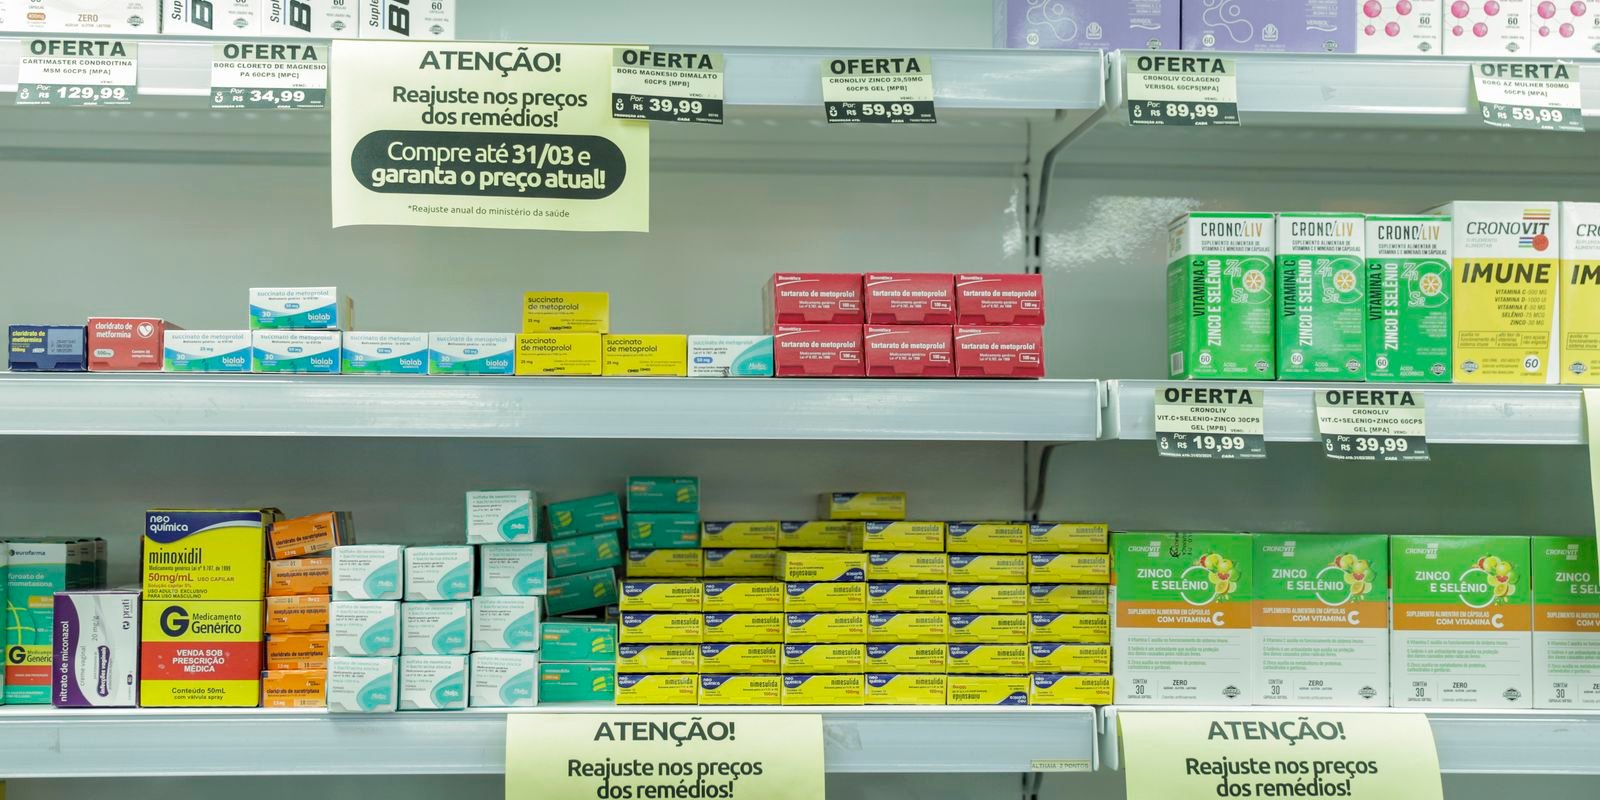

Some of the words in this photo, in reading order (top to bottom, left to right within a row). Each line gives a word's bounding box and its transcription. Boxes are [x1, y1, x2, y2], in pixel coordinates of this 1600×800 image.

[77, 14, 99, 22] ZERO
[1419, 16, 1430, 25] 60
[30, 39, 127, 57] OFERTA
[223, 43, 318, 60] OFERTA
[418, 46, 562, 78] ATENÇÃO!
[622, 49, 713, 70] OFERTA
[830, 57, 921, 75] OFERTA
[1137, 56, 1226, 73] OFERTA
[1480, 63, 1570, 79] OFERTA
[669, 80, 690, 88] [MPB]
[56, 86, 125, 101] 129,99
[249, 90, 305, 104] 34,99
[392, 85, 479, 107] Reajuste
[483, 91, 518, 105] nos
[522, 91, 588, 111] preços
[649, 98, 703, 116] 39,99
[862, 103, 915, 118] 59,99
[1166, 103, 1218, 120] 89,99
[1512, 107, 1563, 123] 59,99
[421, 105, 458, 125] dos
[461, 107, 559, 128] remédios!
[387, 141, 472, 166] Compre
[475, 142, 509, 163] até
[511, 143, 574, 169] 31/03
[577, 150, 592, 166] e
[371, 166, 457, 188] garanta
[460, 170, 476, 186] o
[479, 170, 542, 192] preço
[544, 168, 606, 190] atual!
[450, 205, 474, 214] anual
[475, 206, 487, 215] do
[488, 206, 531, 217] ministério
[532, 208, 543, 217] da
[545, 208, 570, 218] saúde
[1466, 221, 1550, 235] CRONOVIT
[1192, 259, 1205, 267] C
[1461, 262, 1551, 284] IMUNE
[1205, 259, 1222, 304] SELÊNIO
[1382, 262, 1399, 307] SELÊNIO
[527, 296, 564, 304] succinato
[820, 290, 855, 299] metoprolol
[1192, 267, 1206, 317] VITAMINA
[539, 303, 579, 311] metoprolol
[1207, 305, 1222, 313] E
[1384, 309, 1399, 317] E
[1207, 315, 1222, 347] ZINCO
[1384, 318, 1399, 350] ZINCO
[1524, 358, 1539, 369] 60
[1164, 388, 1253, 405] OFERTA
[1325, 390, 1416, 406] OFERTA
[1157, 415, 1236, 423] VIT.C+SELENIO+ZINCO
[1193, 436, 1245, 452] 19,99
[1356, 437, 1408, 454] 39,99
[149, 515, 170, 523] neo
[149, 522, 189, 534] química
[148, 547, 202, 564] minoxidil
[148, 572, 194, 583] 50mg/mL
[1137, 568, 1172, 578] ZINCO
[671, 586, 700, 594] nimesulida
[1152, 581, 1159, 590] E
[1161, 578, 1209, 591] SELÊNIO
[121, 599, 133, 621] prati
[192, 613, 242, 621] Medicamento
[1212, 611, 1225, 626] C
[191, 621, 242, 634] Genérico
[60, 621, 69, 662] miconazol
[176, 649, 205, 657] VENDA
[60, 662, 69, 672] de
[172, 657, 225, 666] PRESCRIÇÃO
[184, 664, 215, 672] MÉDICA
[59, 673, 68, 702] nitrato
[593, 717, 736, 747] ATENÇÃO!
[1207, 717, 1347, 746] ATENÇÃO!
[567, 757, 654, 780] Reajuste
[658, 762, 693, 776] nos
[697, 761, 764, 781] preços
[1185, 756, 1271, 779] Reajuste
[1275, 760, 1310, 775] nos
[1313, 760, 1378, 779] preços
[596, 778, 632, 799] dos
[636, 779, 734, 799] remédios!
[1216, 777, 1251, 797] dos
[1255, 777, 1352, 797] remédios!
